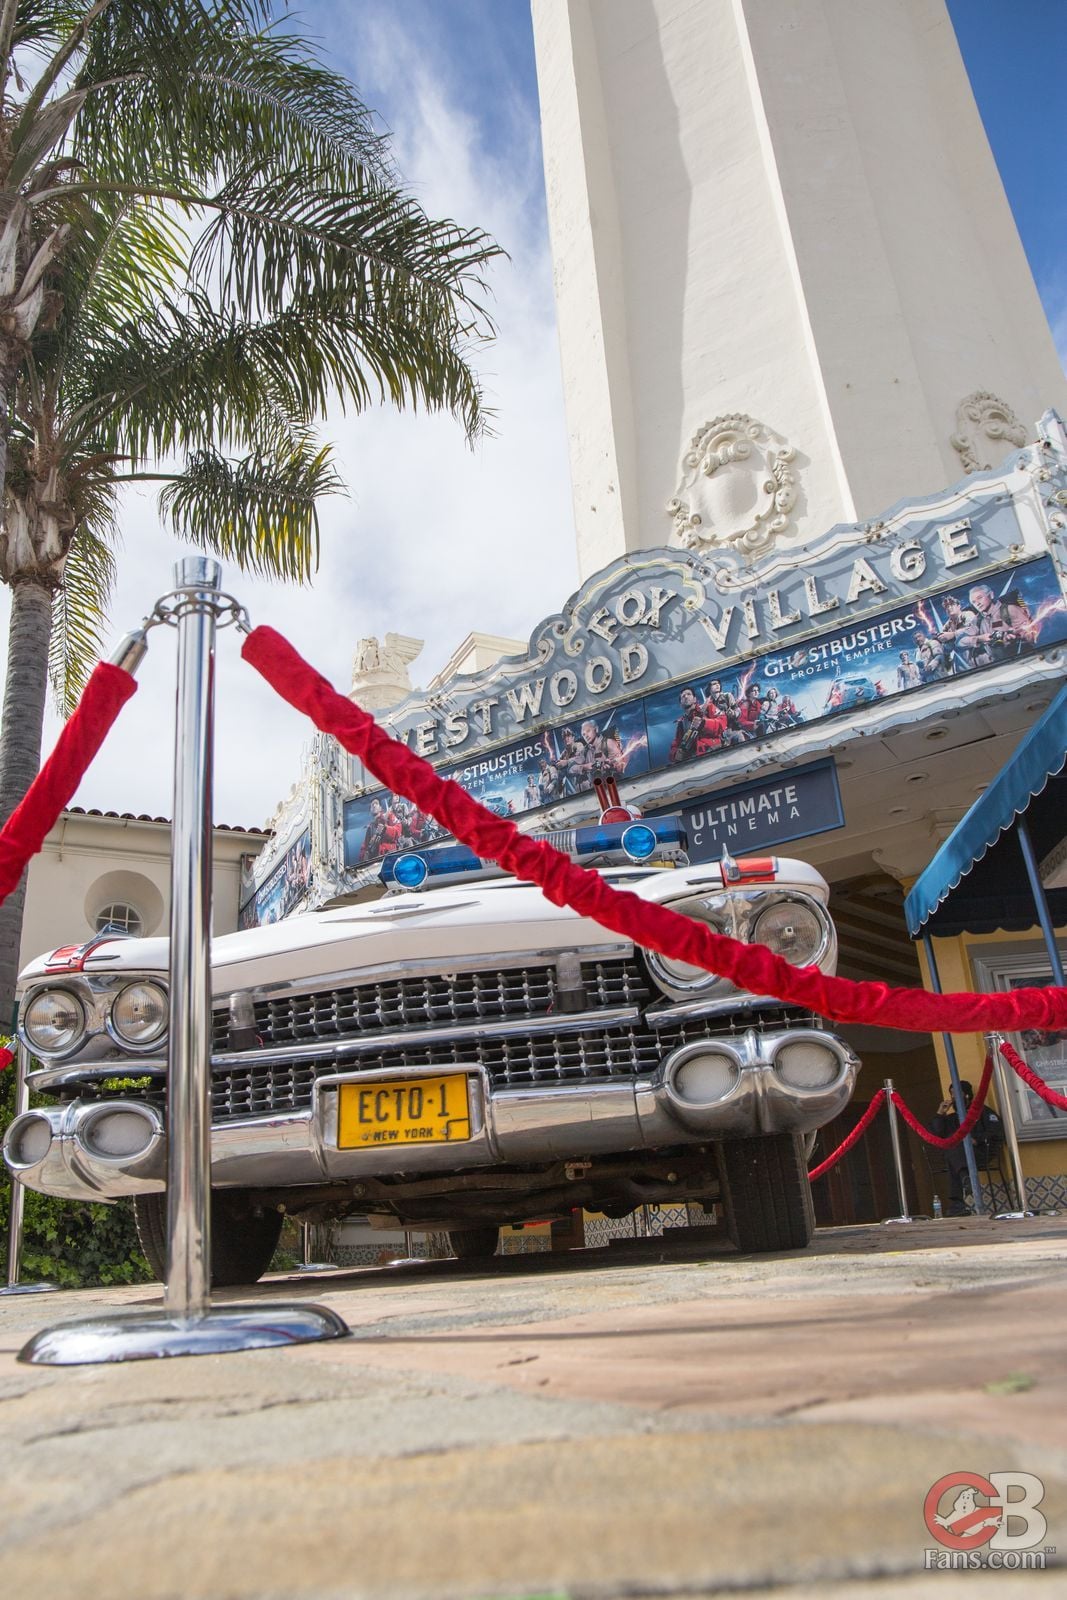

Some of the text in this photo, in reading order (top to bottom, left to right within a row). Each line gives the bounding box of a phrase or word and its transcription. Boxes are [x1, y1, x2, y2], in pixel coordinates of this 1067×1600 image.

[699, 517, 979, 651] VILLAGE
[587, 586, 677, 646] FOX
[791, 640, 893, 680] FROZEN EMPIRE
[489, 764, 524, 781] EMPIRE
[691, 785, 798, 830] ULTIMATE
[693, 806, 801, 845] CINEMA
[358, 1084, 450, 1124] ECTO-1
[373, 1127, 434, 1141] NEW YORK
